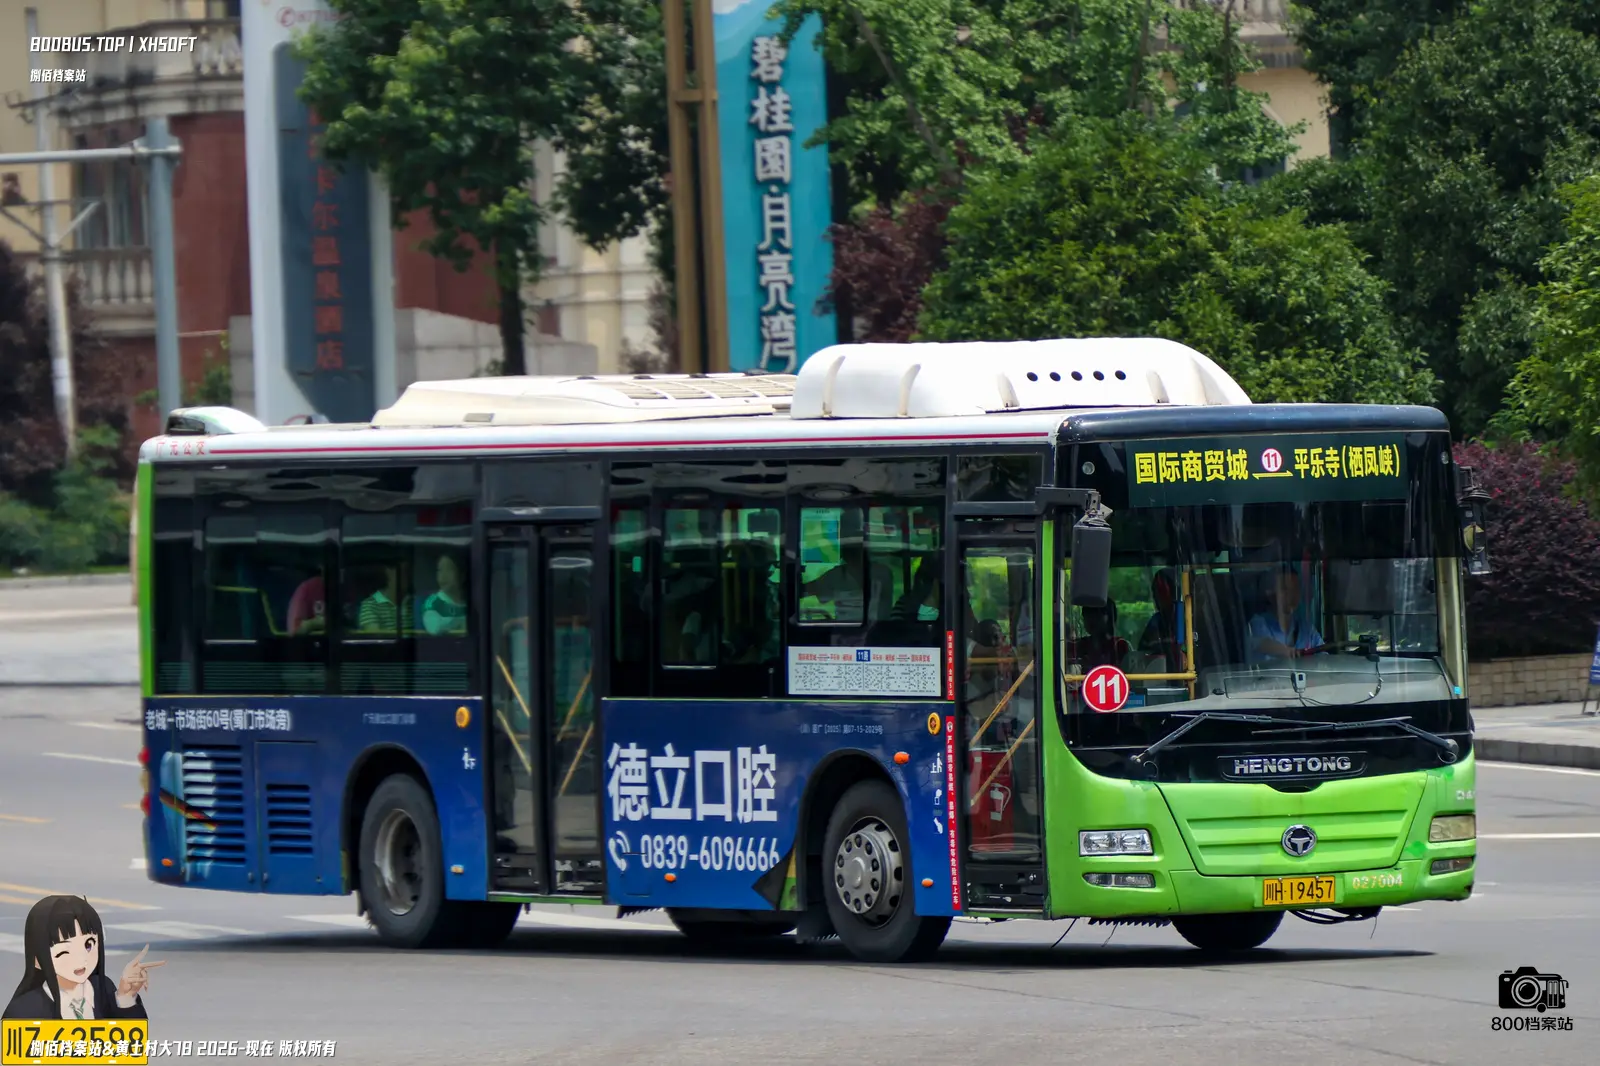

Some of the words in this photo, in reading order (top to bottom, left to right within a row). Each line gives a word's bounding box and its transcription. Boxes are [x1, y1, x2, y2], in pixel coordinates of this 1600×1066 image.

[1134, 449, 1249, 484] 国际商贸城
[1264, 452, 1279, 469] 11
[1294, 444, 1400, 479] 平乐寺(栖凤峡)
[1092, 673, 1121, 704] 11
[1234, 756, 1351, 775] HENGTONG
[607, 742, 778, 824] 德立口腔
[640, 834, 780, 871] 0839-6096666
[1352, 873, 1404, 890] 027004
